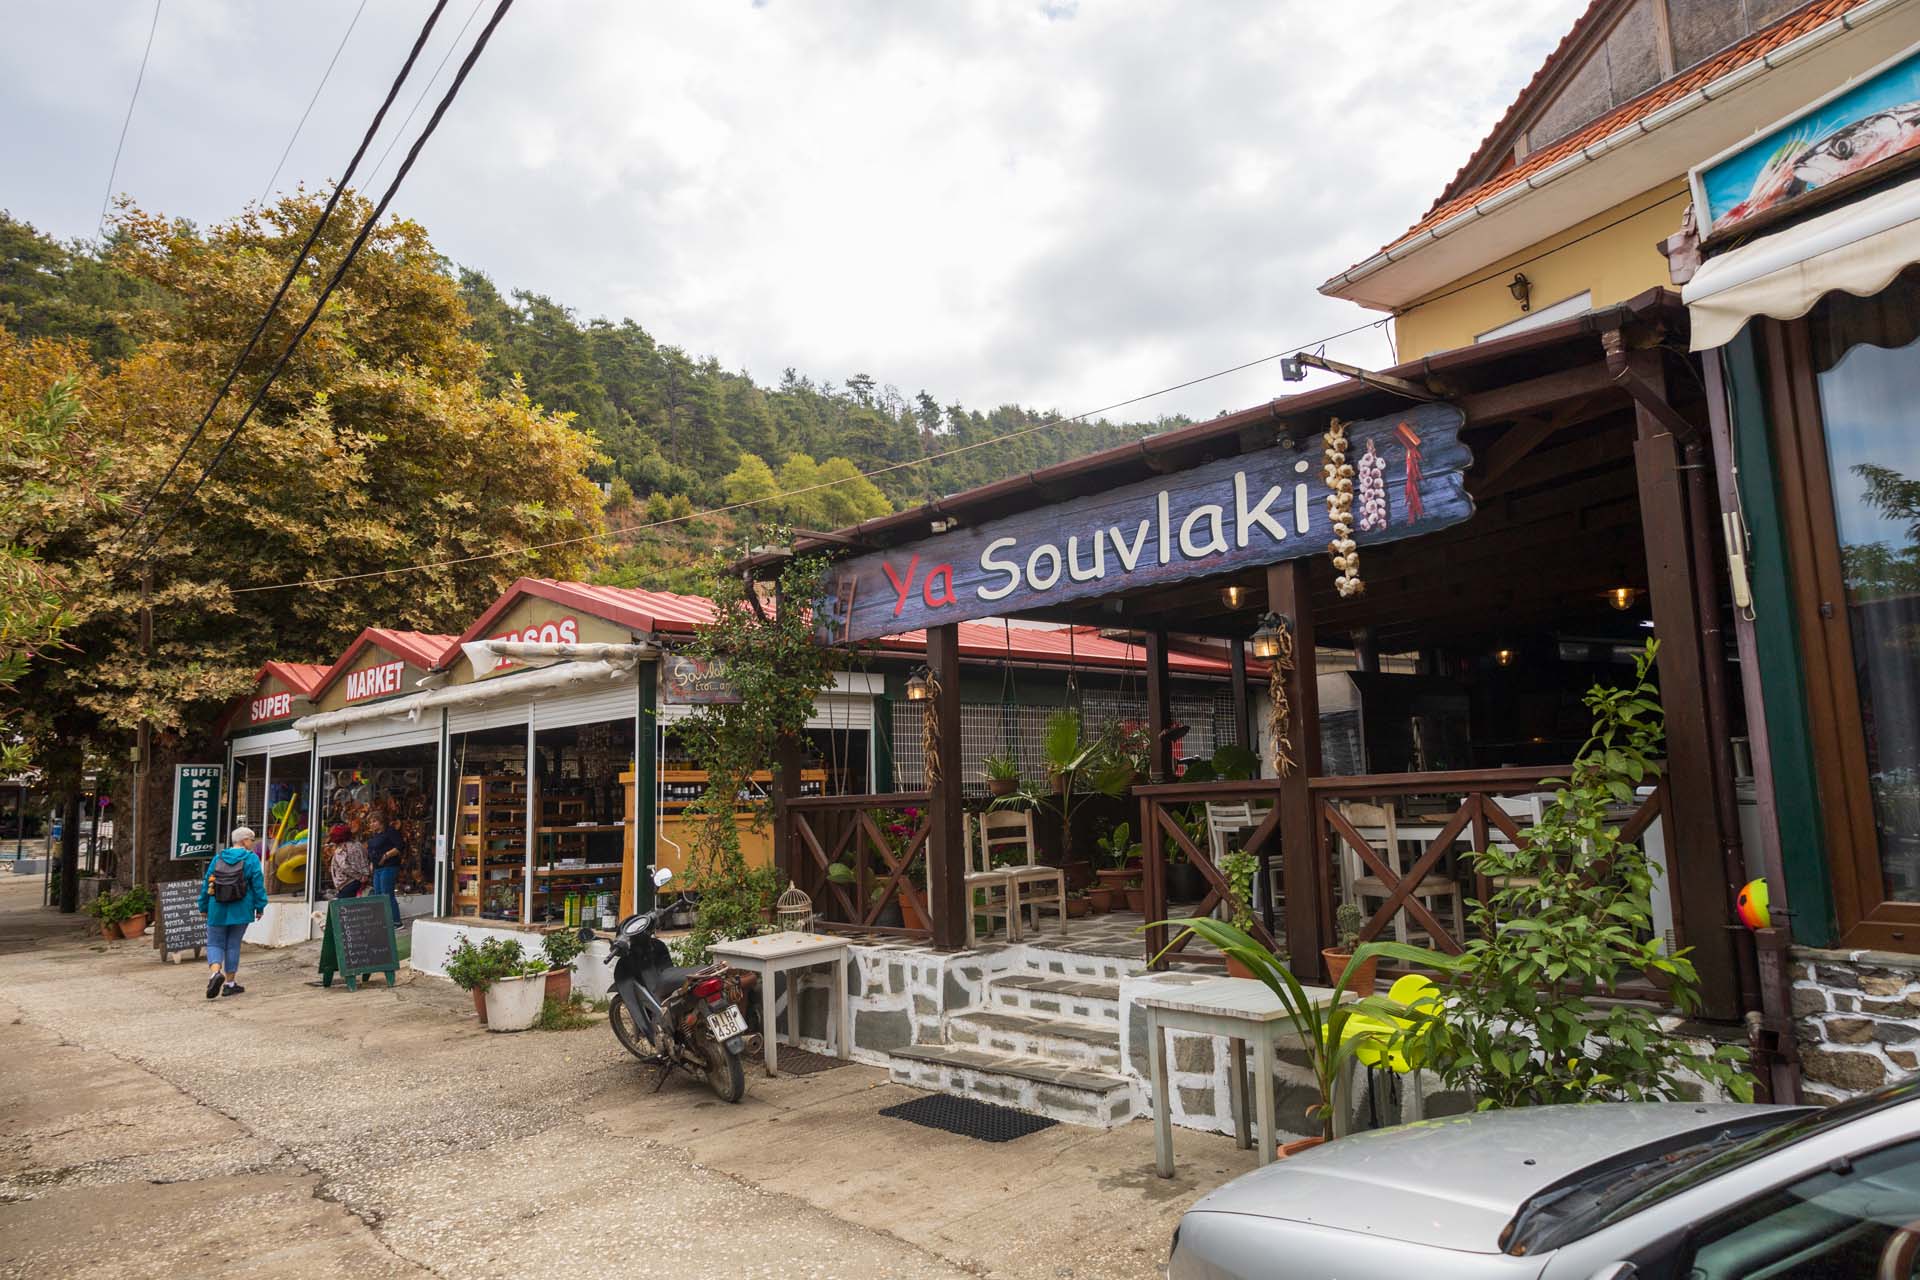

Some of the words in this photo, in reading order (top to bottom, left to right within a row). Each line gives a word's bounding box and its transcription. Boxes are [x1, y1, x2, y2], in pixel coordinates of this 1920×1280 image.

[882, 554, 957, 616] Ya
[976, 461, 1310, 600] Souvlaki
[346, 661, 404, 701] MARKET
[251, 693, 290, 721] SUPER
[182, 768, 219, 777] SUPER
[191, 779, 211, 841] MARKET
[718, 1021, 738, 1037] 438
